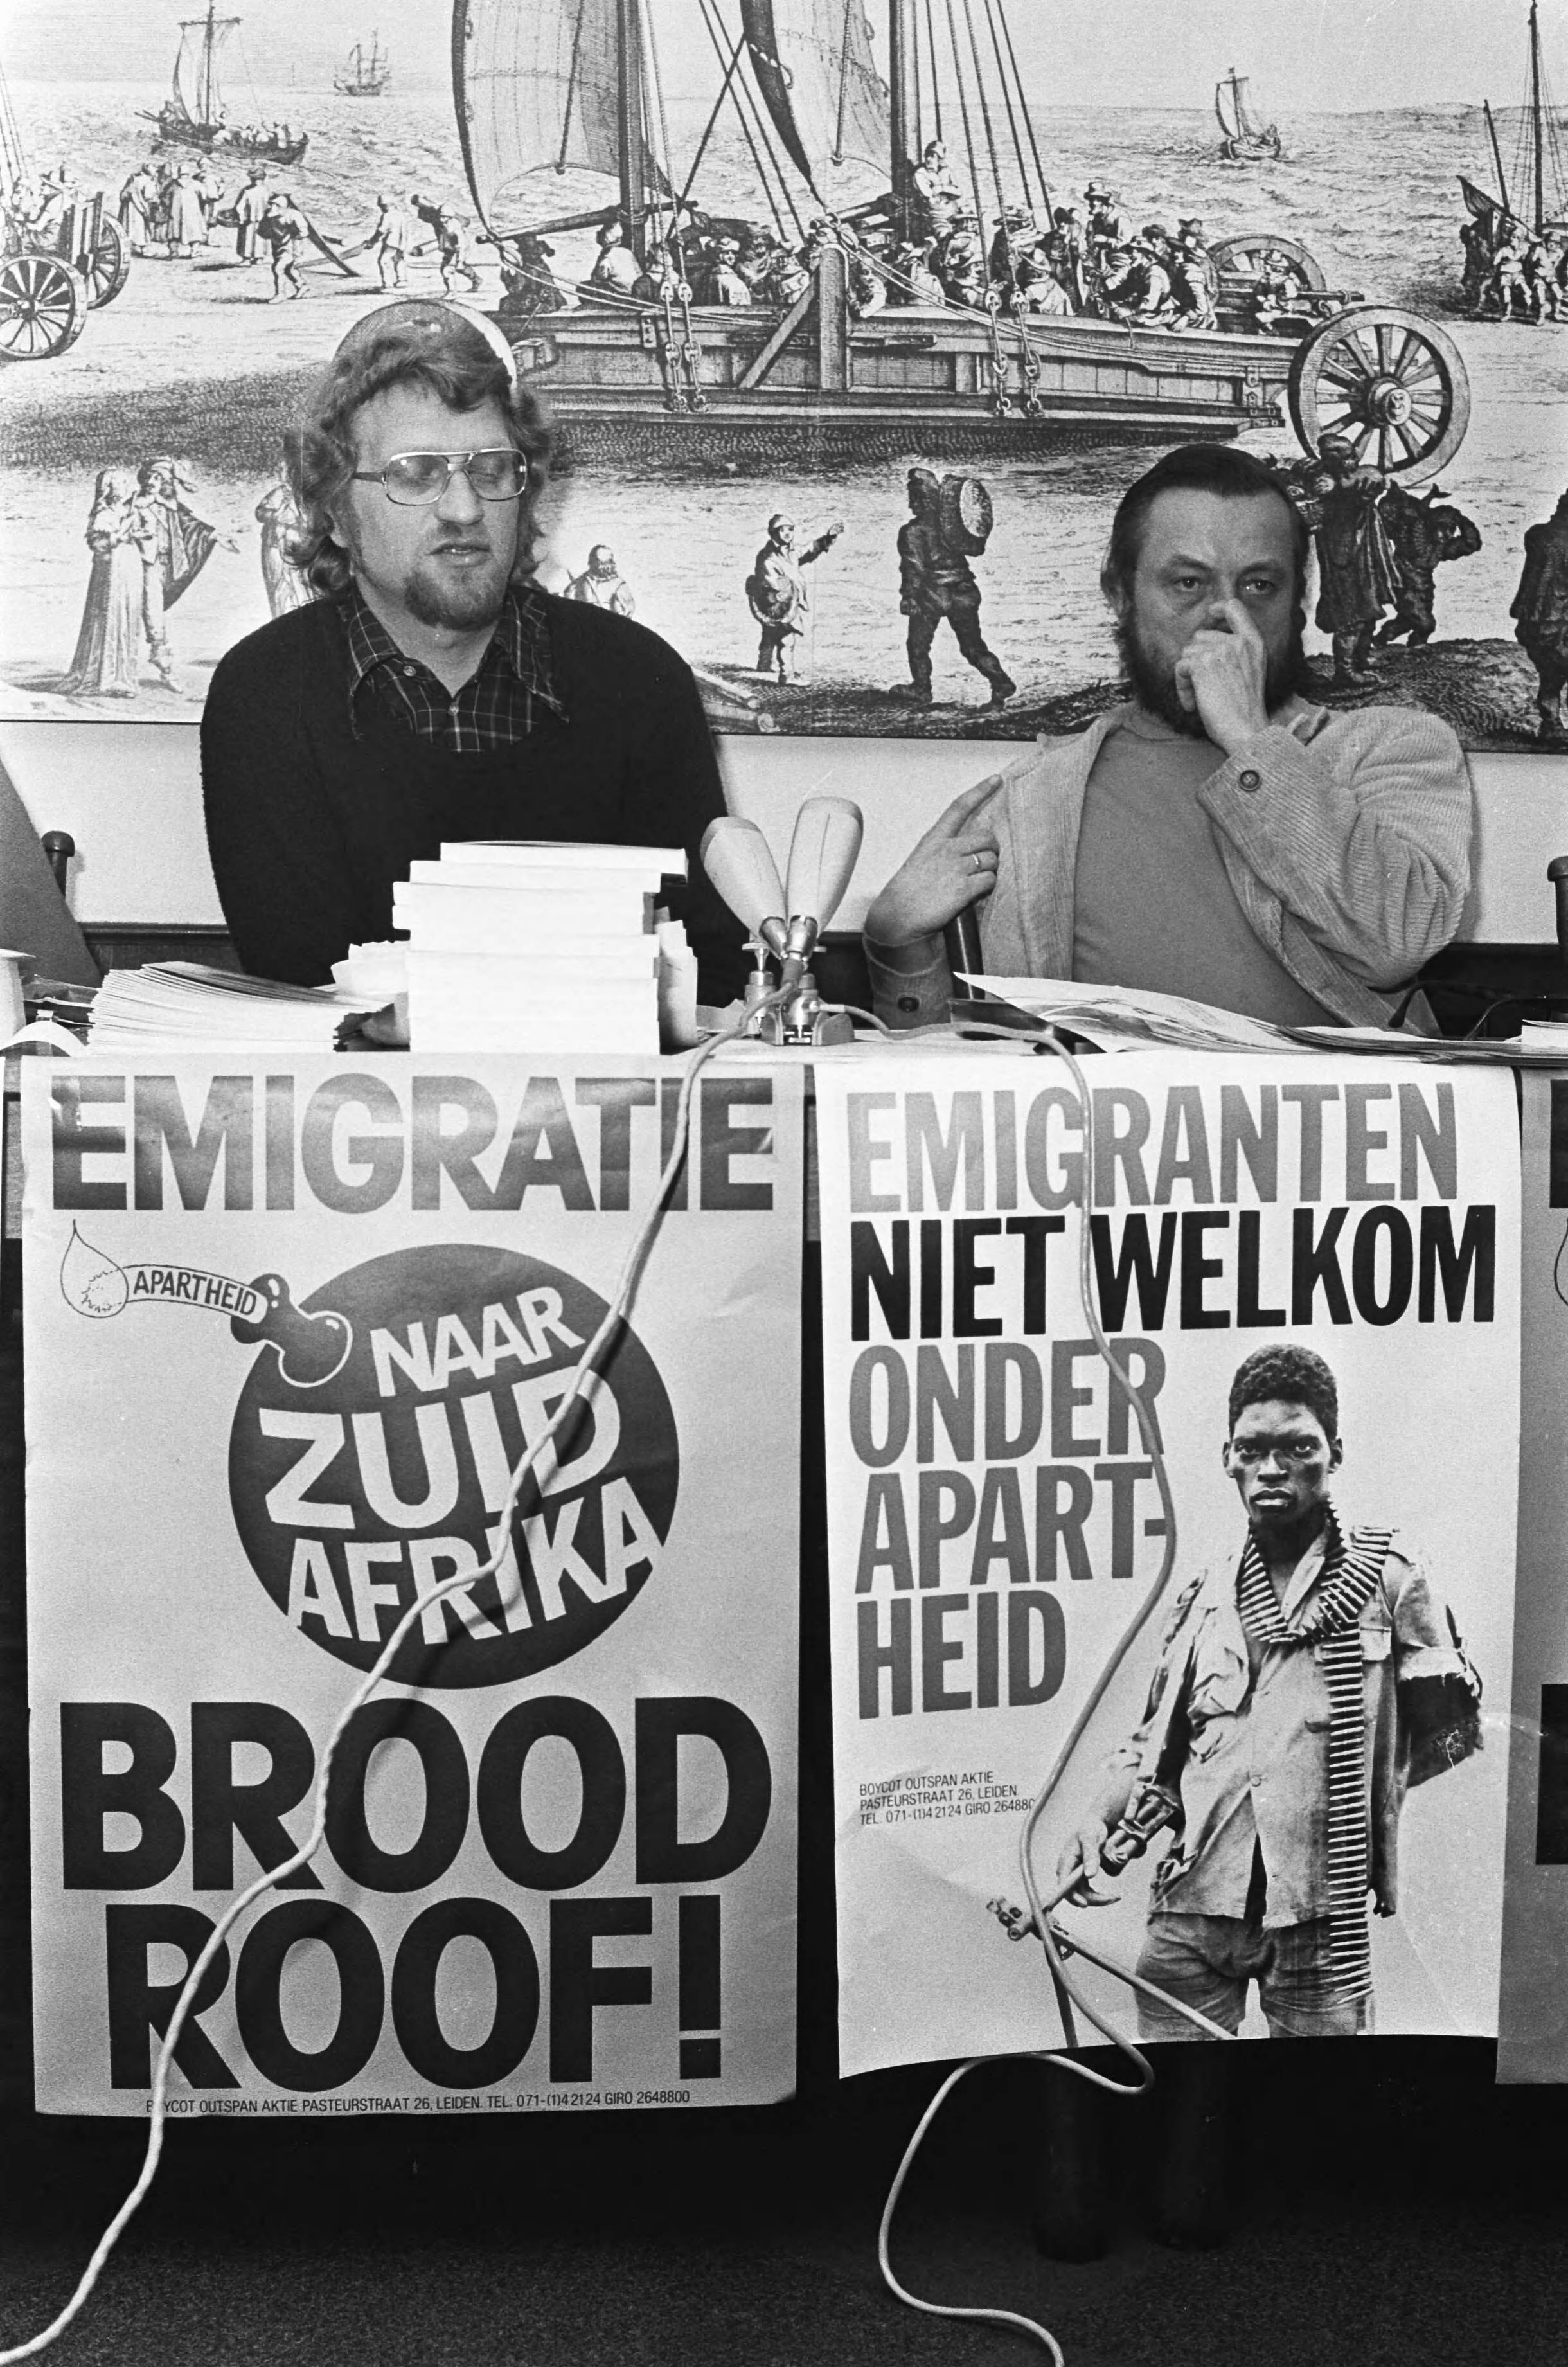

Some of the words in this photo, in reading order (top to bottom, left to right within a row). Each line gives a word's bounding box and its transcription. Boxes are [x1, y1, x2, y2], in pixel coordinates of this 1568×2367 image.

[51, 1073, 773, 1214] EMIGRATIE
[846, 1082, 1457, 1213] EMIGRANTEN
[133, 1270, 256, 1316] APARTHEID
[851, 1215, 1065, 1341] NIET
[1091, 1205, 1496, 1332] WELKOM
[370, 1286, 585, 1397] NAAR
[849, 1337, 1165, 1467] ONDER
[258, 1364, 621, 1530] ZUID
[288, 1476, 664, 1645] AFRIKA
[855, 1462, 1167, 1593] APART-
[858, 1590, 1067, 1720] HEID
[60, 1695, 771, 1893] BROOD
[860, 1779, 901, 1796] BOYCOT
[905, 1774, 958, 1790] OUTSPAN
[961, 1771, 993, 1785] AKTIE
[860, 1789, 954, 1811] PASTEURSTRAAT
[965, 1801, 990, 1816] GIRO
[105, 1894, 721, 2093] ROOF!
[147, 2099, 195, 2113] BYCOT
[200, 2100, 257, 2113] OUTSPAN
[262, 2100, 297, 2112] AKTIE
[303, 2098, 410, 2112] PASTEURSTRAAT
[605, 2091, 633, 2105] GIRO
[637, 2090, 690, 2104] 2648800
